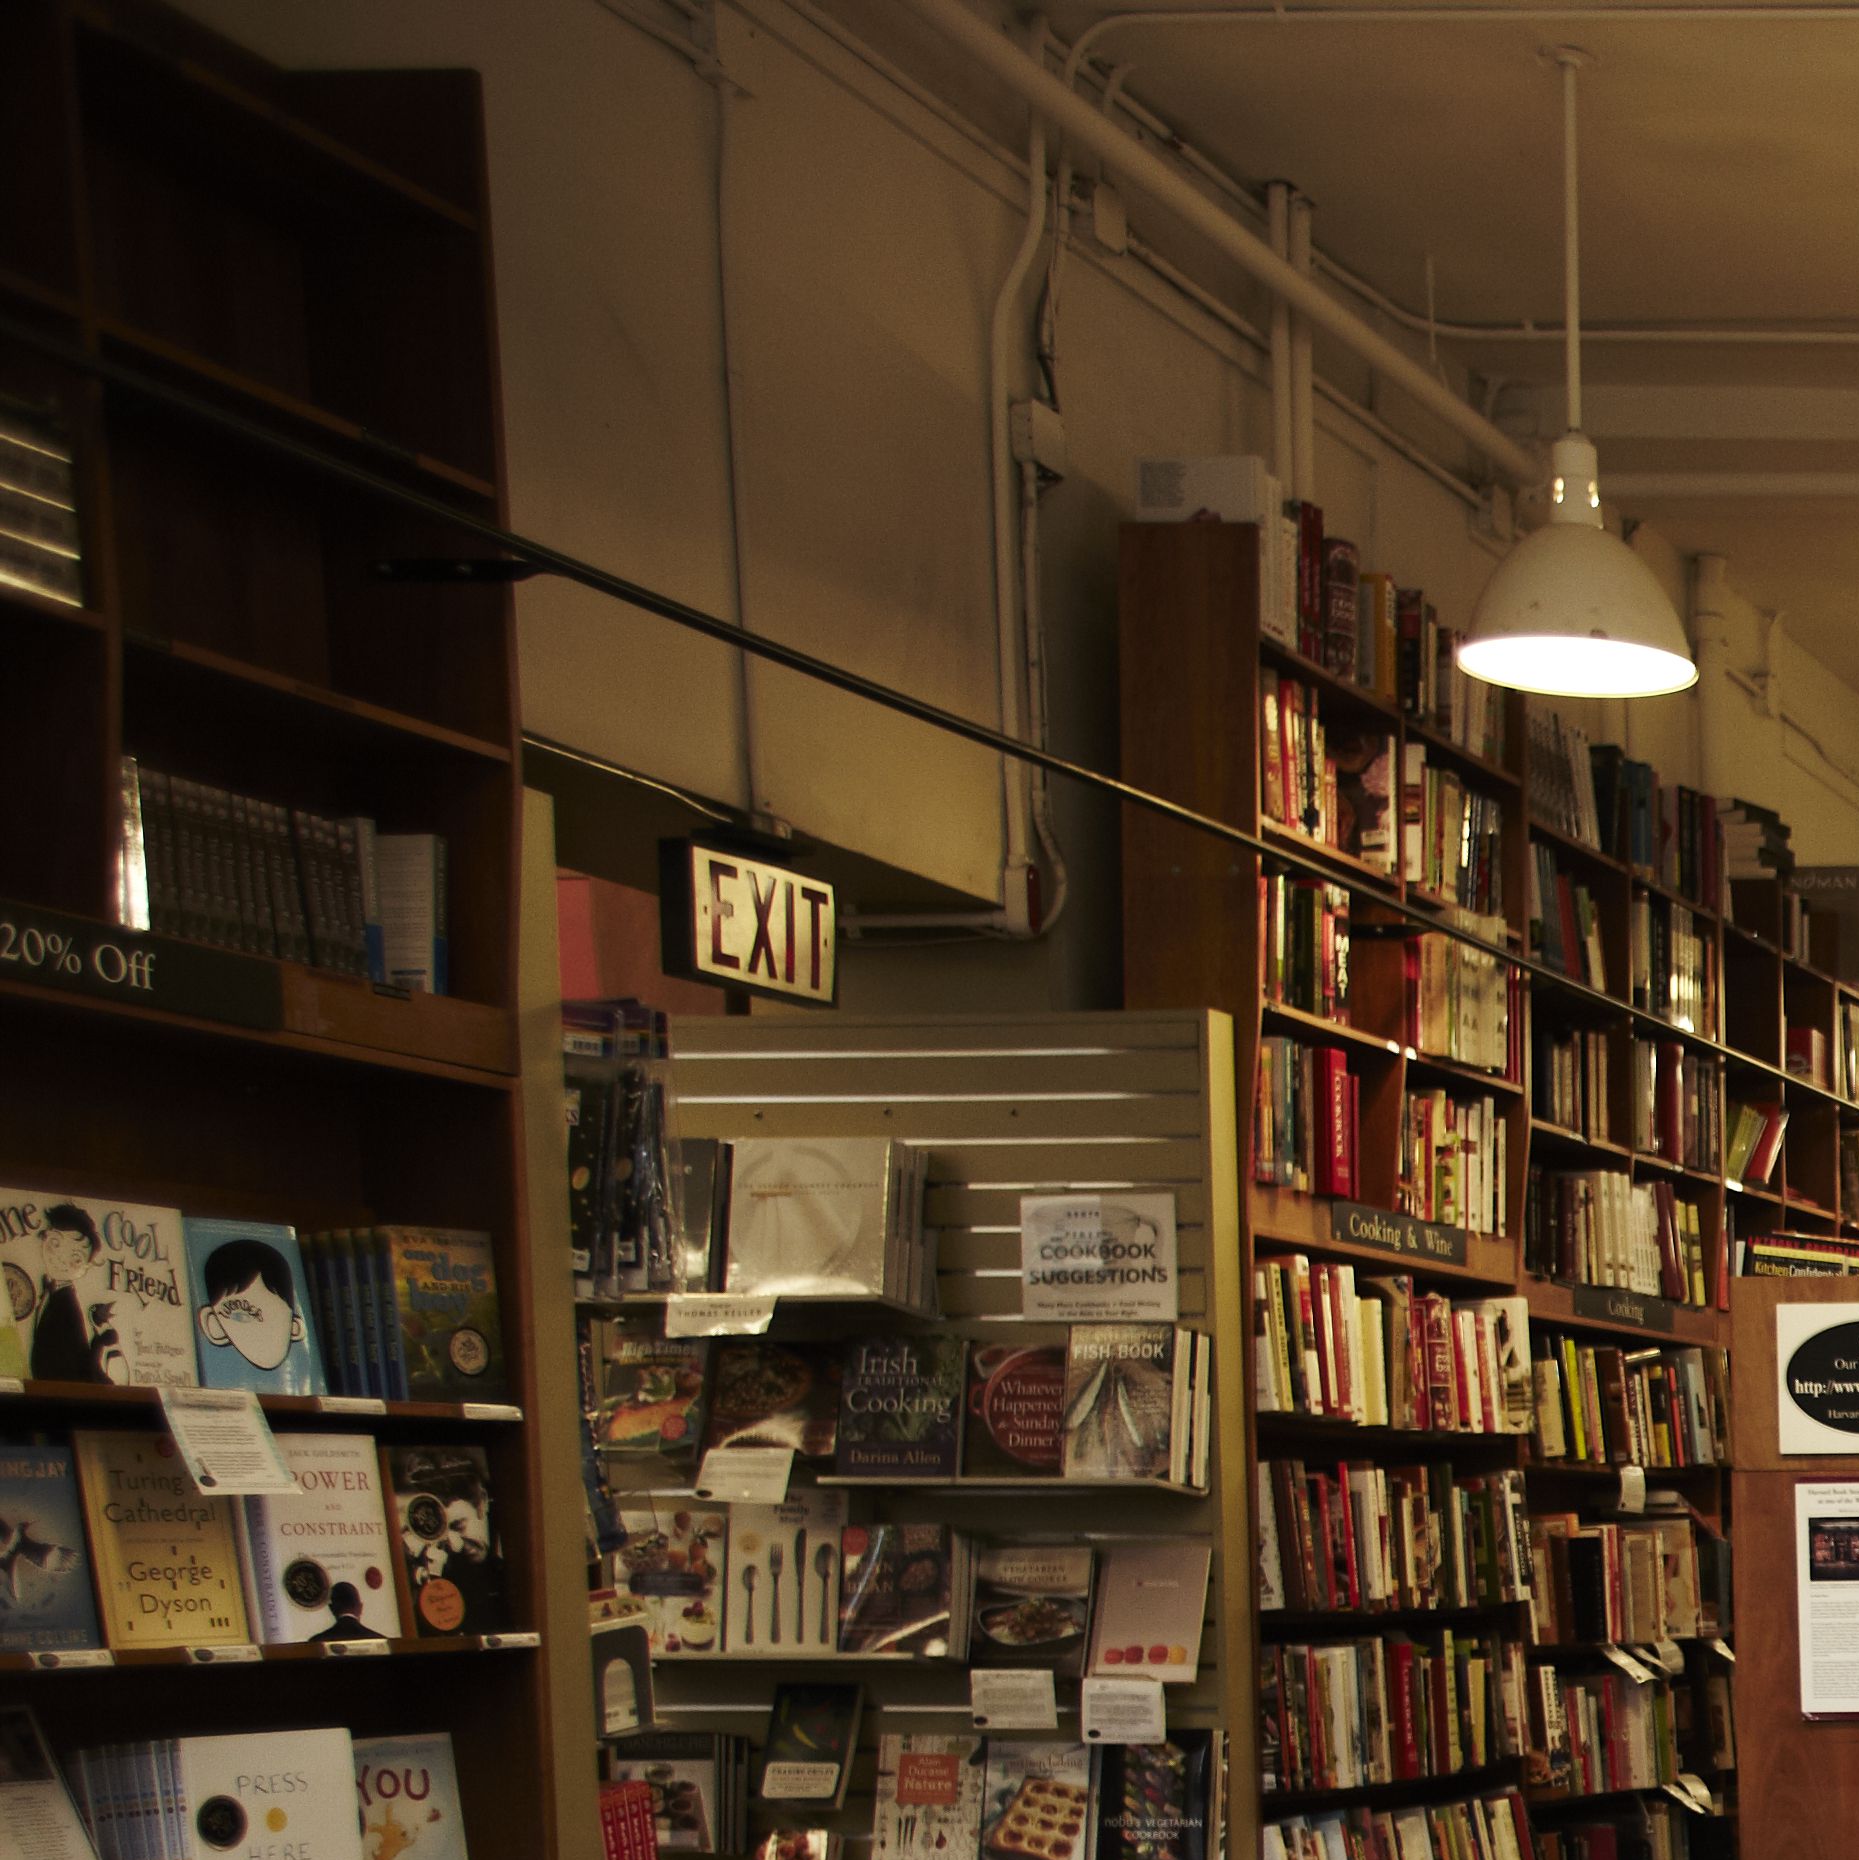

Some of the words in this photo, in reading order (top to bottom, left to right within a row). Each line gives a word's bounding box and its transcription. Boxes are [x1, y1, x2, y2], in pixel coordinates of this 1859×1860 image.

[709, 860, 828, 992] EXIT
[1, 924, 82, 976] 20%
[95, 945, 155, 992] Off
[1350, 1214, 1401, 1253] Cooking
[1406, 1226, 1418, 1246] &
[1423, 1231, 1453, 1258] Wine
[1040, 1242, 1156, 1261] COOKBOOK
[1029, 1266, 1168, 1286] SUGGESTIONS
[860, 1348, 918, 1375] Irish
[1834, 1358, 1858, 1371] Our
[847, 1389, 951, 1423] Cooking
